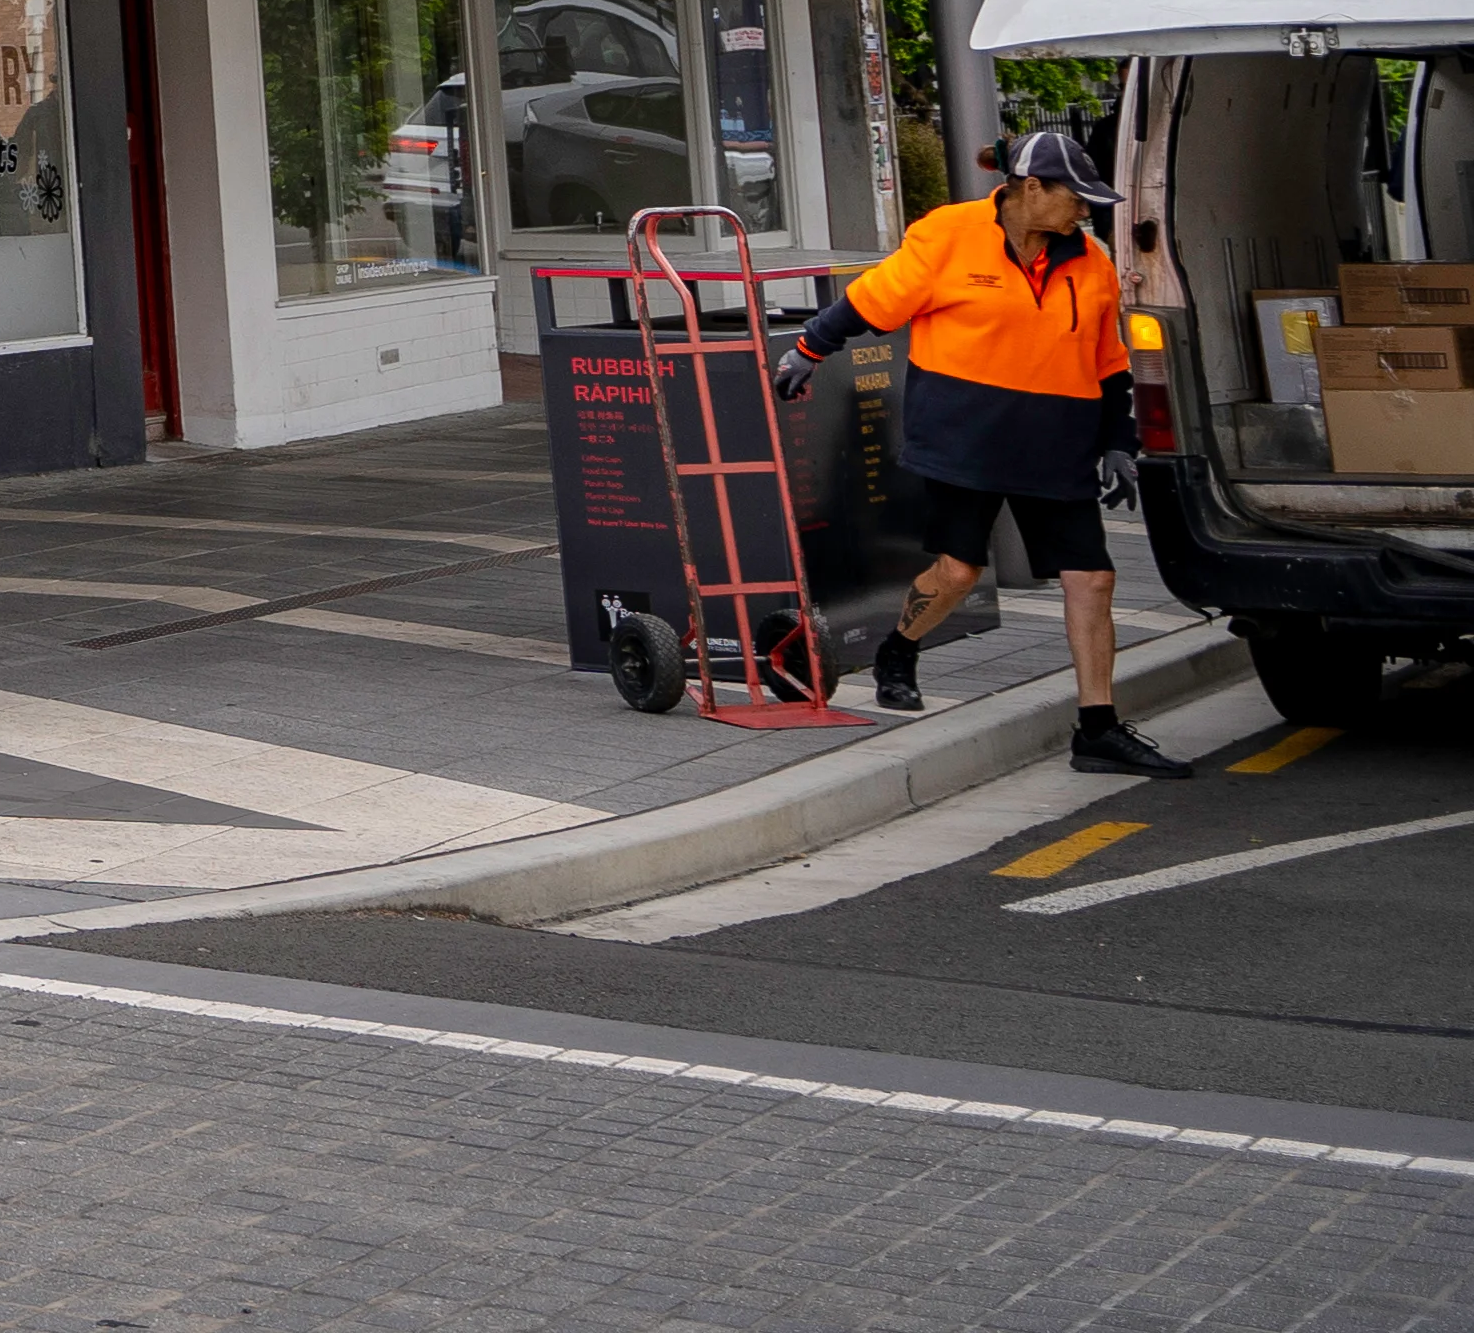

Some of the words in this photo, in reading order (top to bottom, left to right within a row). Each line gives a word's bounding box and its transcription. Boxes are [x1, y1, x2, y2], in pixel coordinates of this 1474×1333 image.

[851, 344, 893, 365] RECYCLING
[854, 371, 892, 392] HAKARUA
[707, 638, 739, 649] UNEDIN
